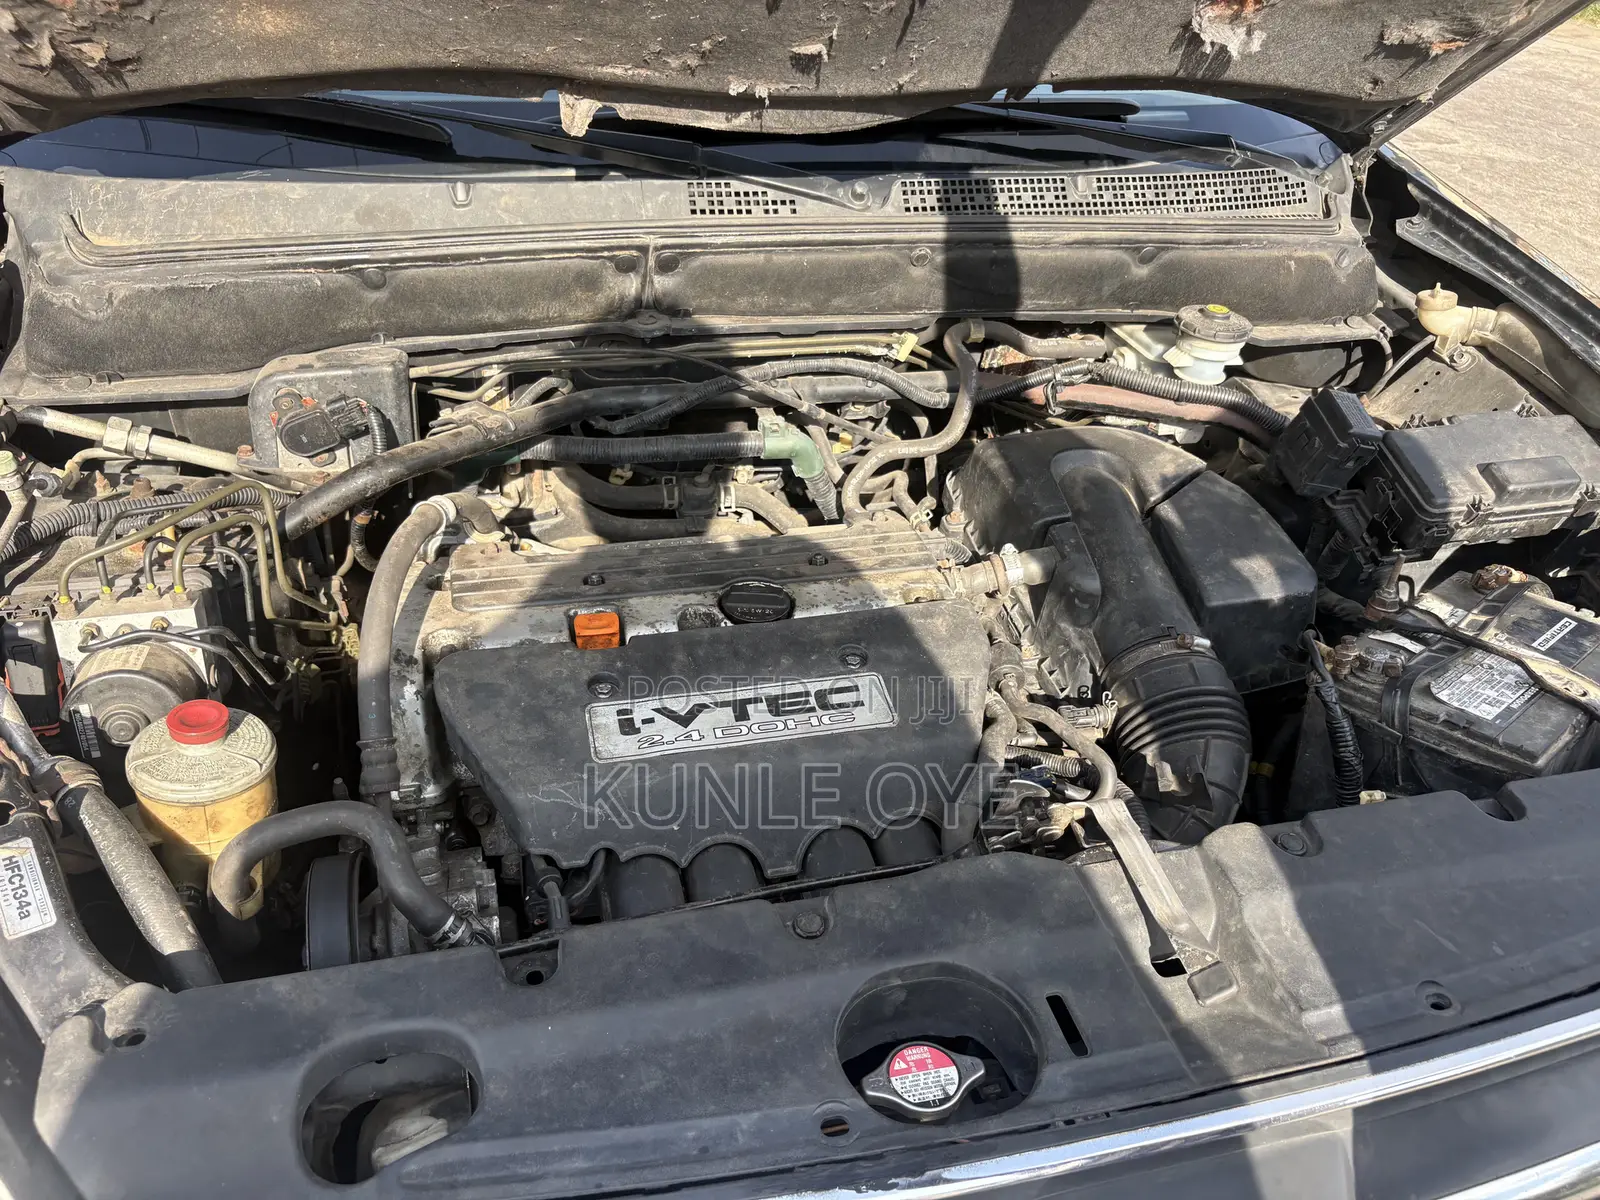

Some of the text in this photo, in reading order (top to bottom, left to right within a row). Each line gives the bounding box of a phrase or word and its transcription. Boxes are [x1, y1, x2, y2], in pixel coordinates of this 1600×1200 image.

[636, 711, 856, 751] 2.4 DOHC
[2, 854, 32, 921] HFC134a
[904, 1046, 929, 1056] DANGER
